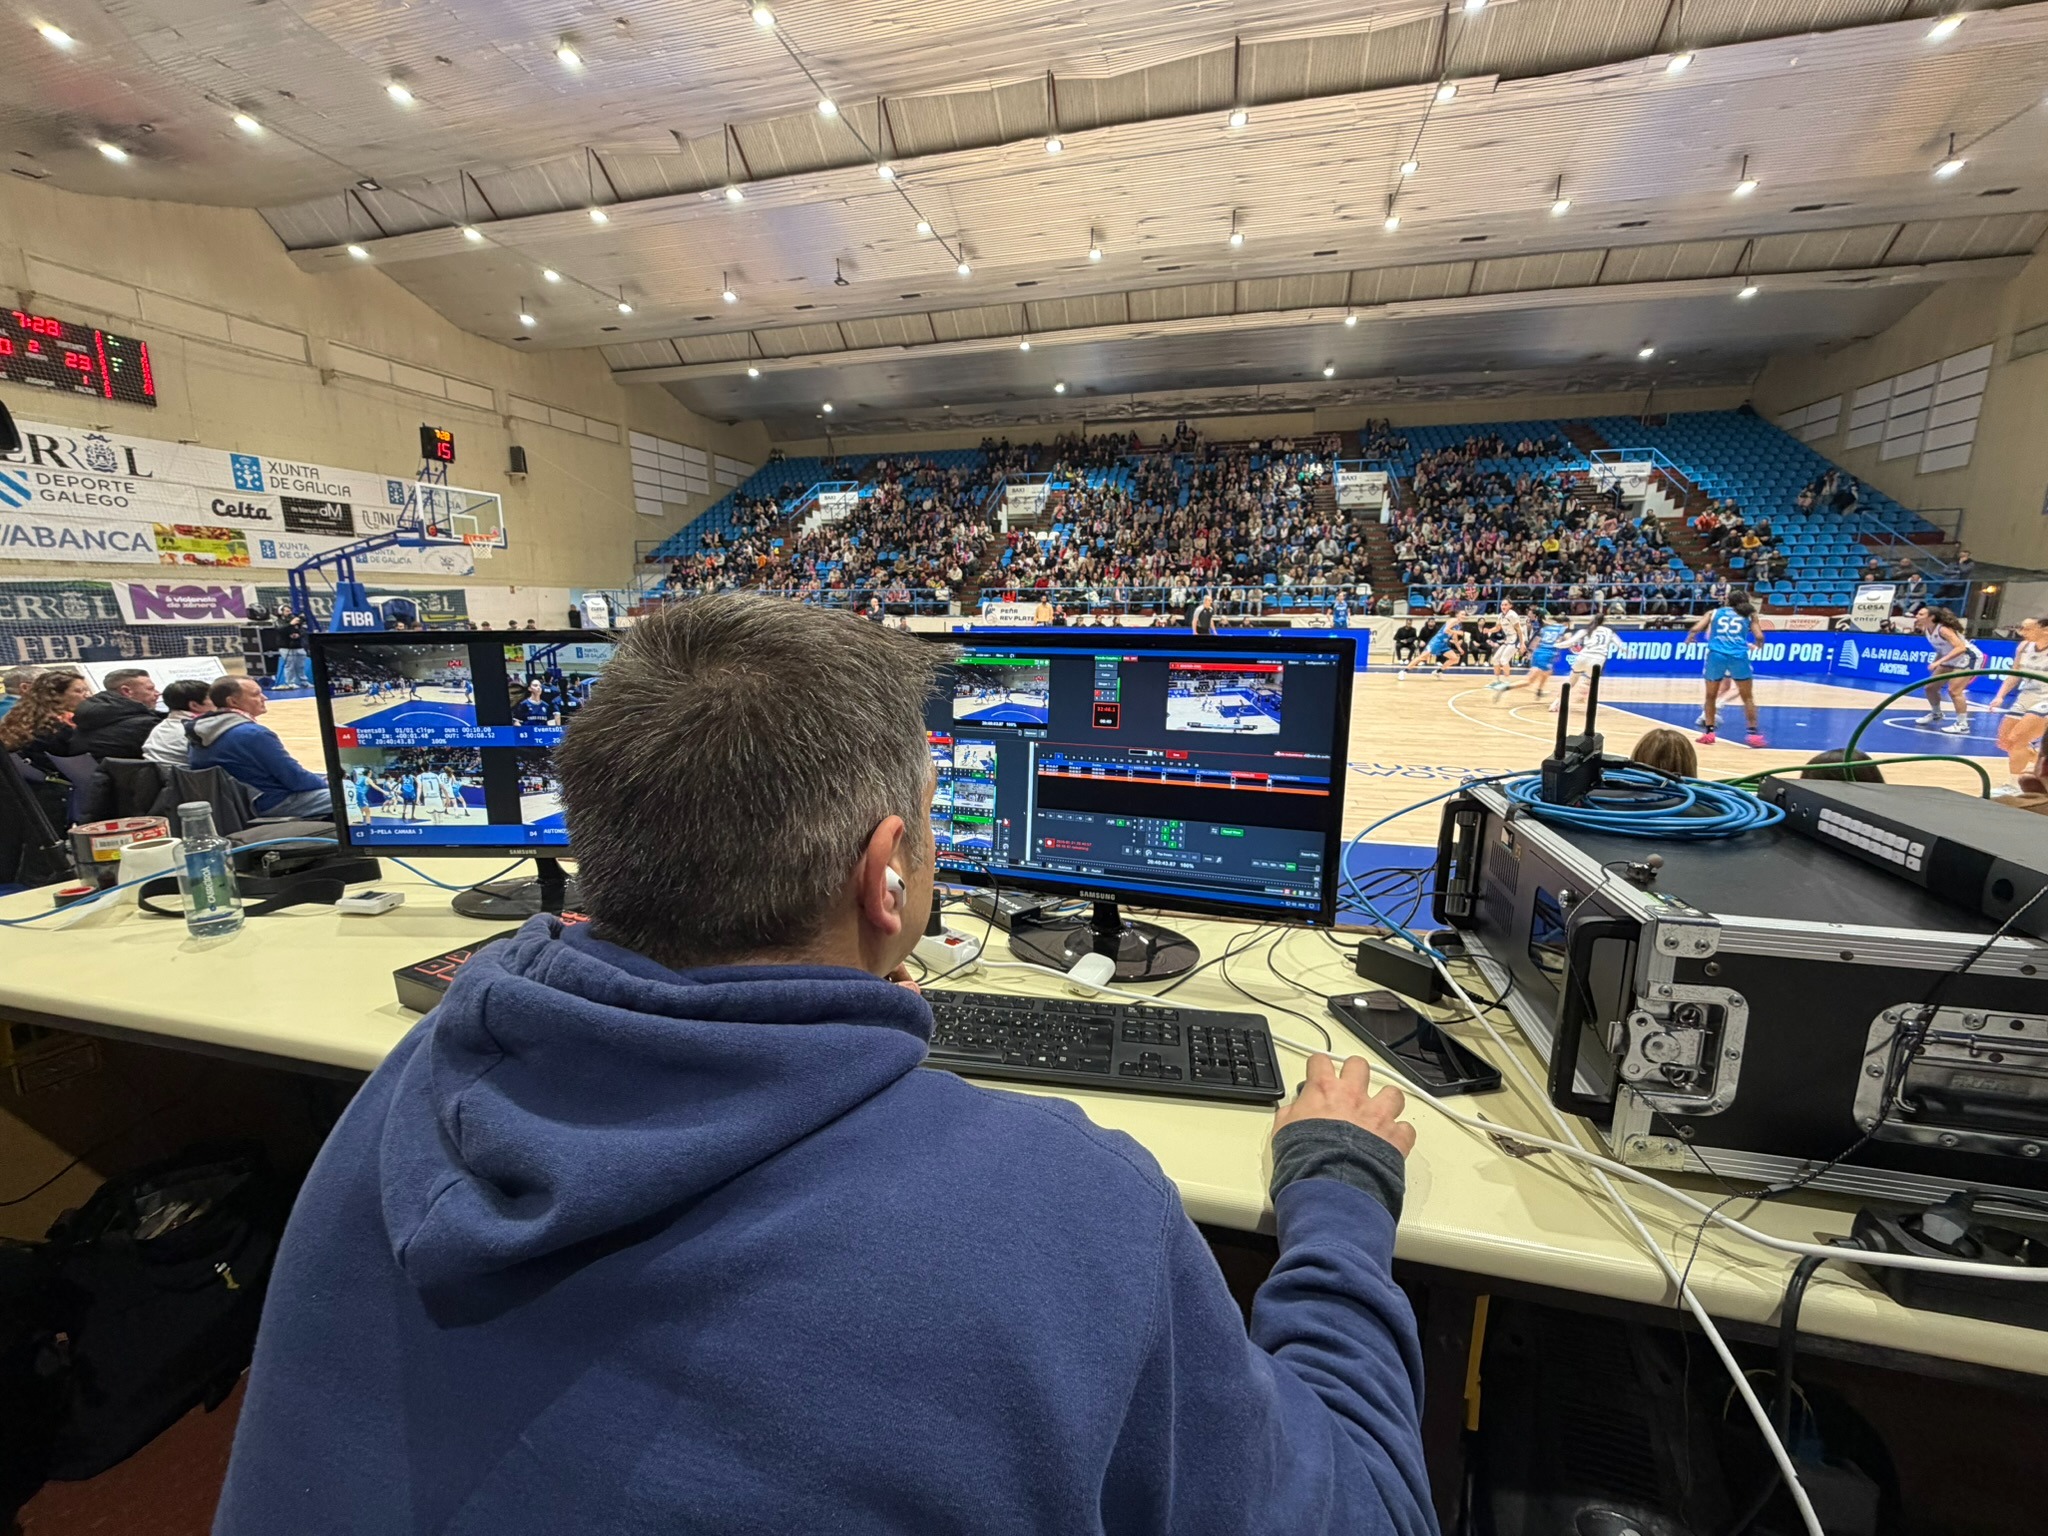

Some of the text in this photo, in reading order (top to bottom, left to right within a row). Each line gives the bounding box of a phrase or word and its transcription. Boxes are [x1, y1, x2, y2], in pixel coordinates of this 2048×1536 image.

[12, 310, 62, 338] 7:28
[65, 351, 93, 371] 23
[438, 442, 451, 459] 15
[267, 461, 320, 480] XUNTA
[36, 472, 136, 494] DEPORTE
[270, 476, 352, 498] DE GALICIA
[40, 489, 129, 508] GALEGO
[211, 499, 273, 520] Celta
[279, 542, 310, 550] XUNTA
[128, 584, 249, 620] NON
[342, 611, 375, 627] FIBA
[1716, 616, 1742, 634] 55
[1607, 641, 1672, 660] PARTIDO
[1789, 643, 1824, 662] POR
[1861, 646, 1937, 664] ALMIRANTE
[1879, 662, 1910, 676] HOTEL
[1079, 889, 1116, 901] SAMSUNG
